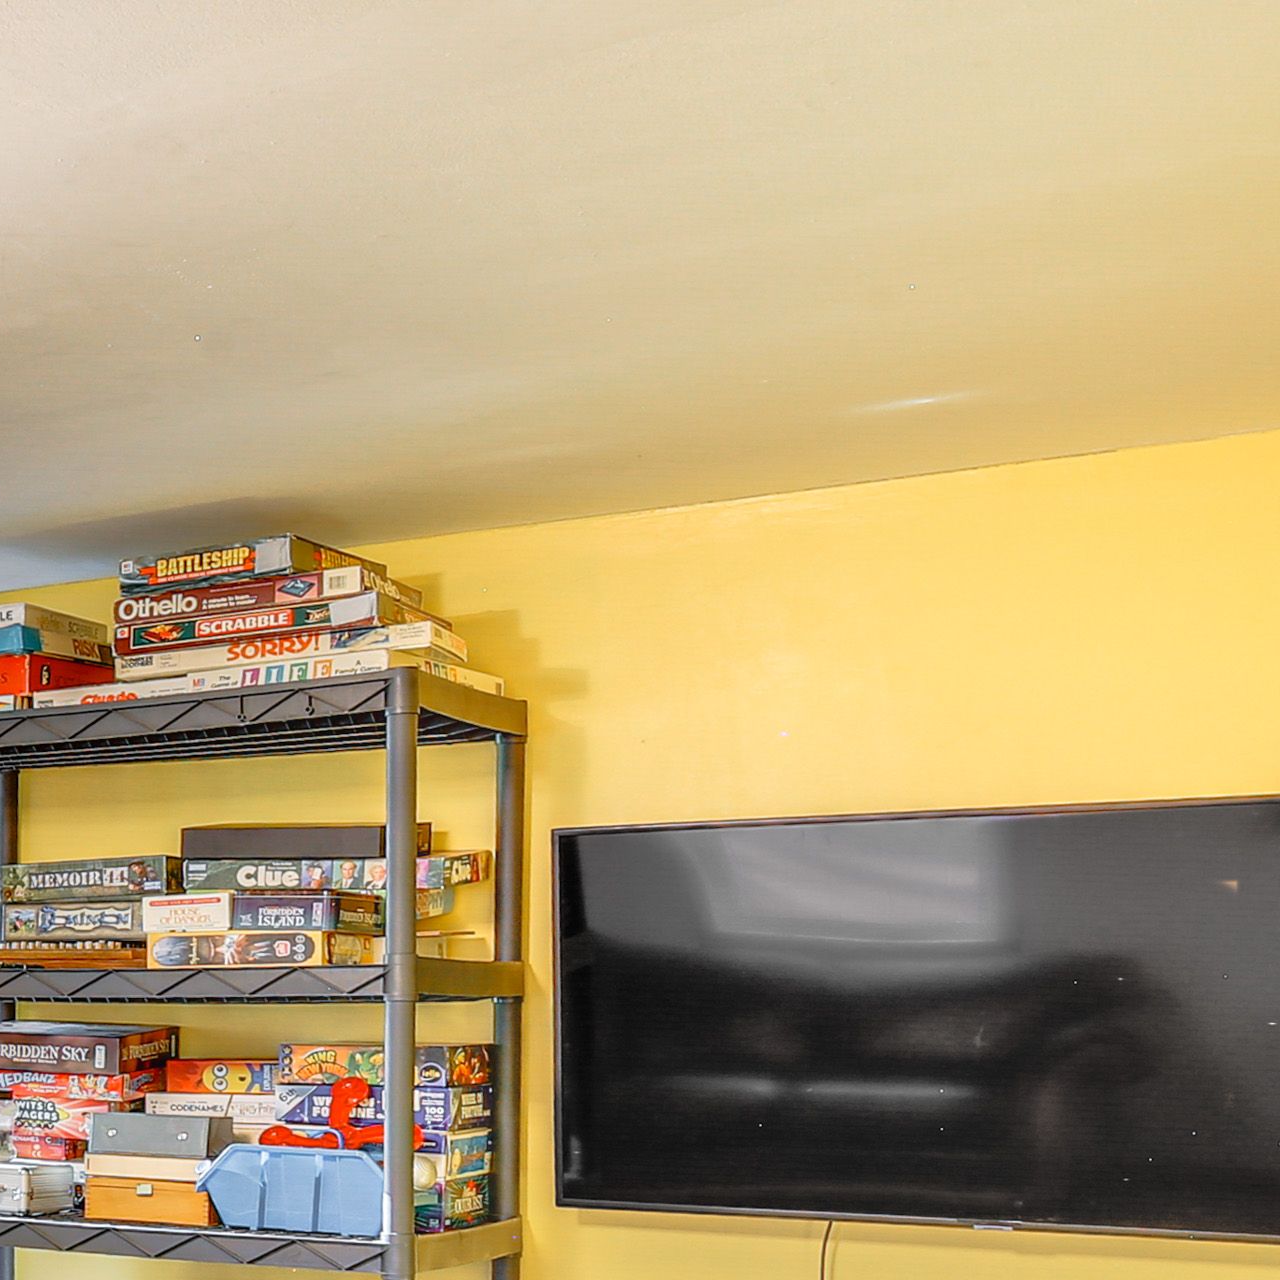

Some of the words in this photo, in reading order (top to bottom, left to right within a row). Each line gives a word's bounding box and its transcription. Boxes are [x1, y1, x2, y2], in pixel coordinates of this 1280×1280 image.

[156, 546, 250, 578] BATTLESHIP
[118, 592, 198, 621] Othello
[199, 611, 289, 635] SCRABBLE
[72, 638, 101, 661] RISK
[226, 631, 321, 662] SORRY!
[243, 660, 332, 687] LIFE
[335, 667, 358, 675] Family
[30, 871, 102, 889] MEMOIR
[236, 865, 300, 888] Clue
[257, 914, 305, 927] ISLAND
[258, 906, 305, 917] FORBIDDEN
[62, 1046, 90, 1061] SKY
[305, 1049, 336, 1064] KING
[295, 1062, 321, 1081] NEW
[278, 1087, 298, 1103] 6th
[169, 1103, 225, 1113] CODENAMES
[424, 1106, 445, 1115] 100
